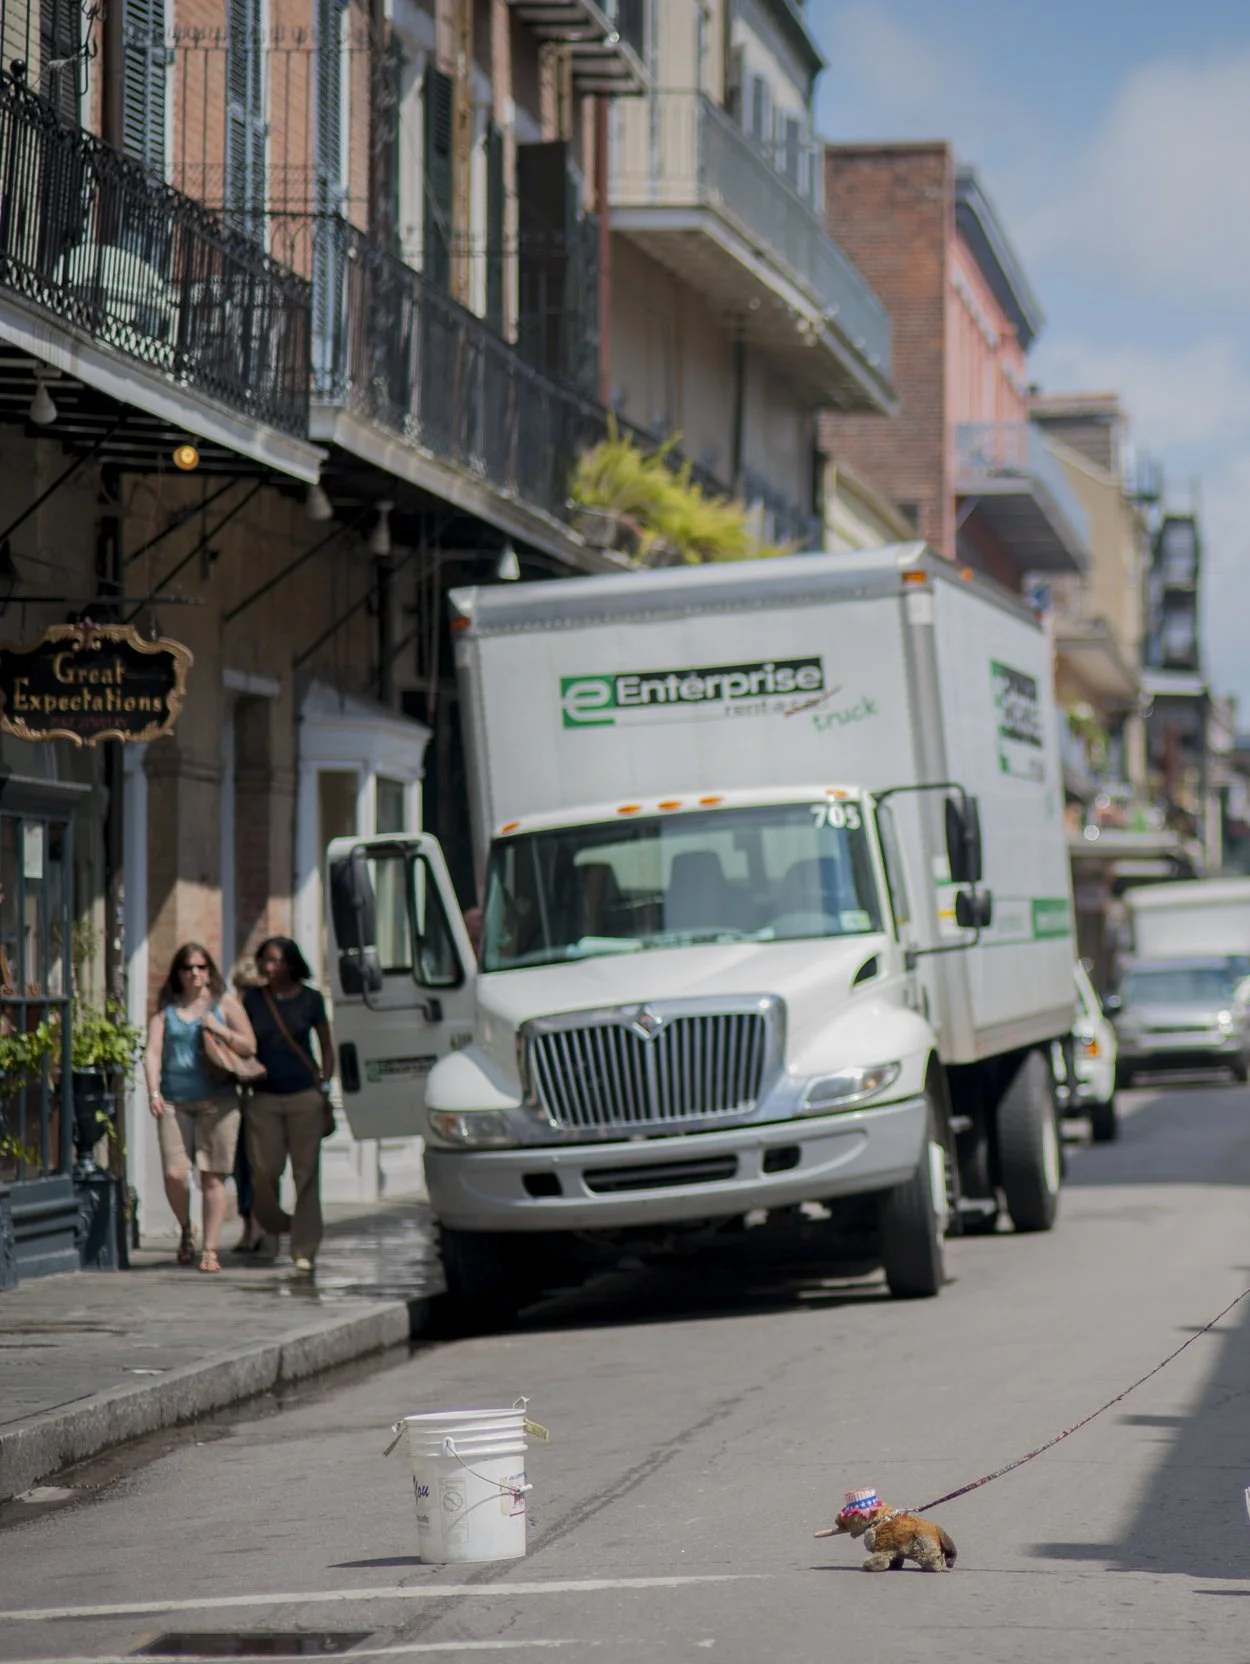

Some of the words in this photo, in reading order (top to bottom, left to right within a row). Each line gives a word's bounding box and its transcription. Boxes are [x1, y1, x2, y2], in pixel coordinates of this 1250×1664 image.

[53, 652, 126, 685] Great
[616, 663, 823, 706] Enterprise
[13, 677, 163, 714] Expectations
[724, 700, 767, 716] rent
[811, 697, 878, 733] truck
